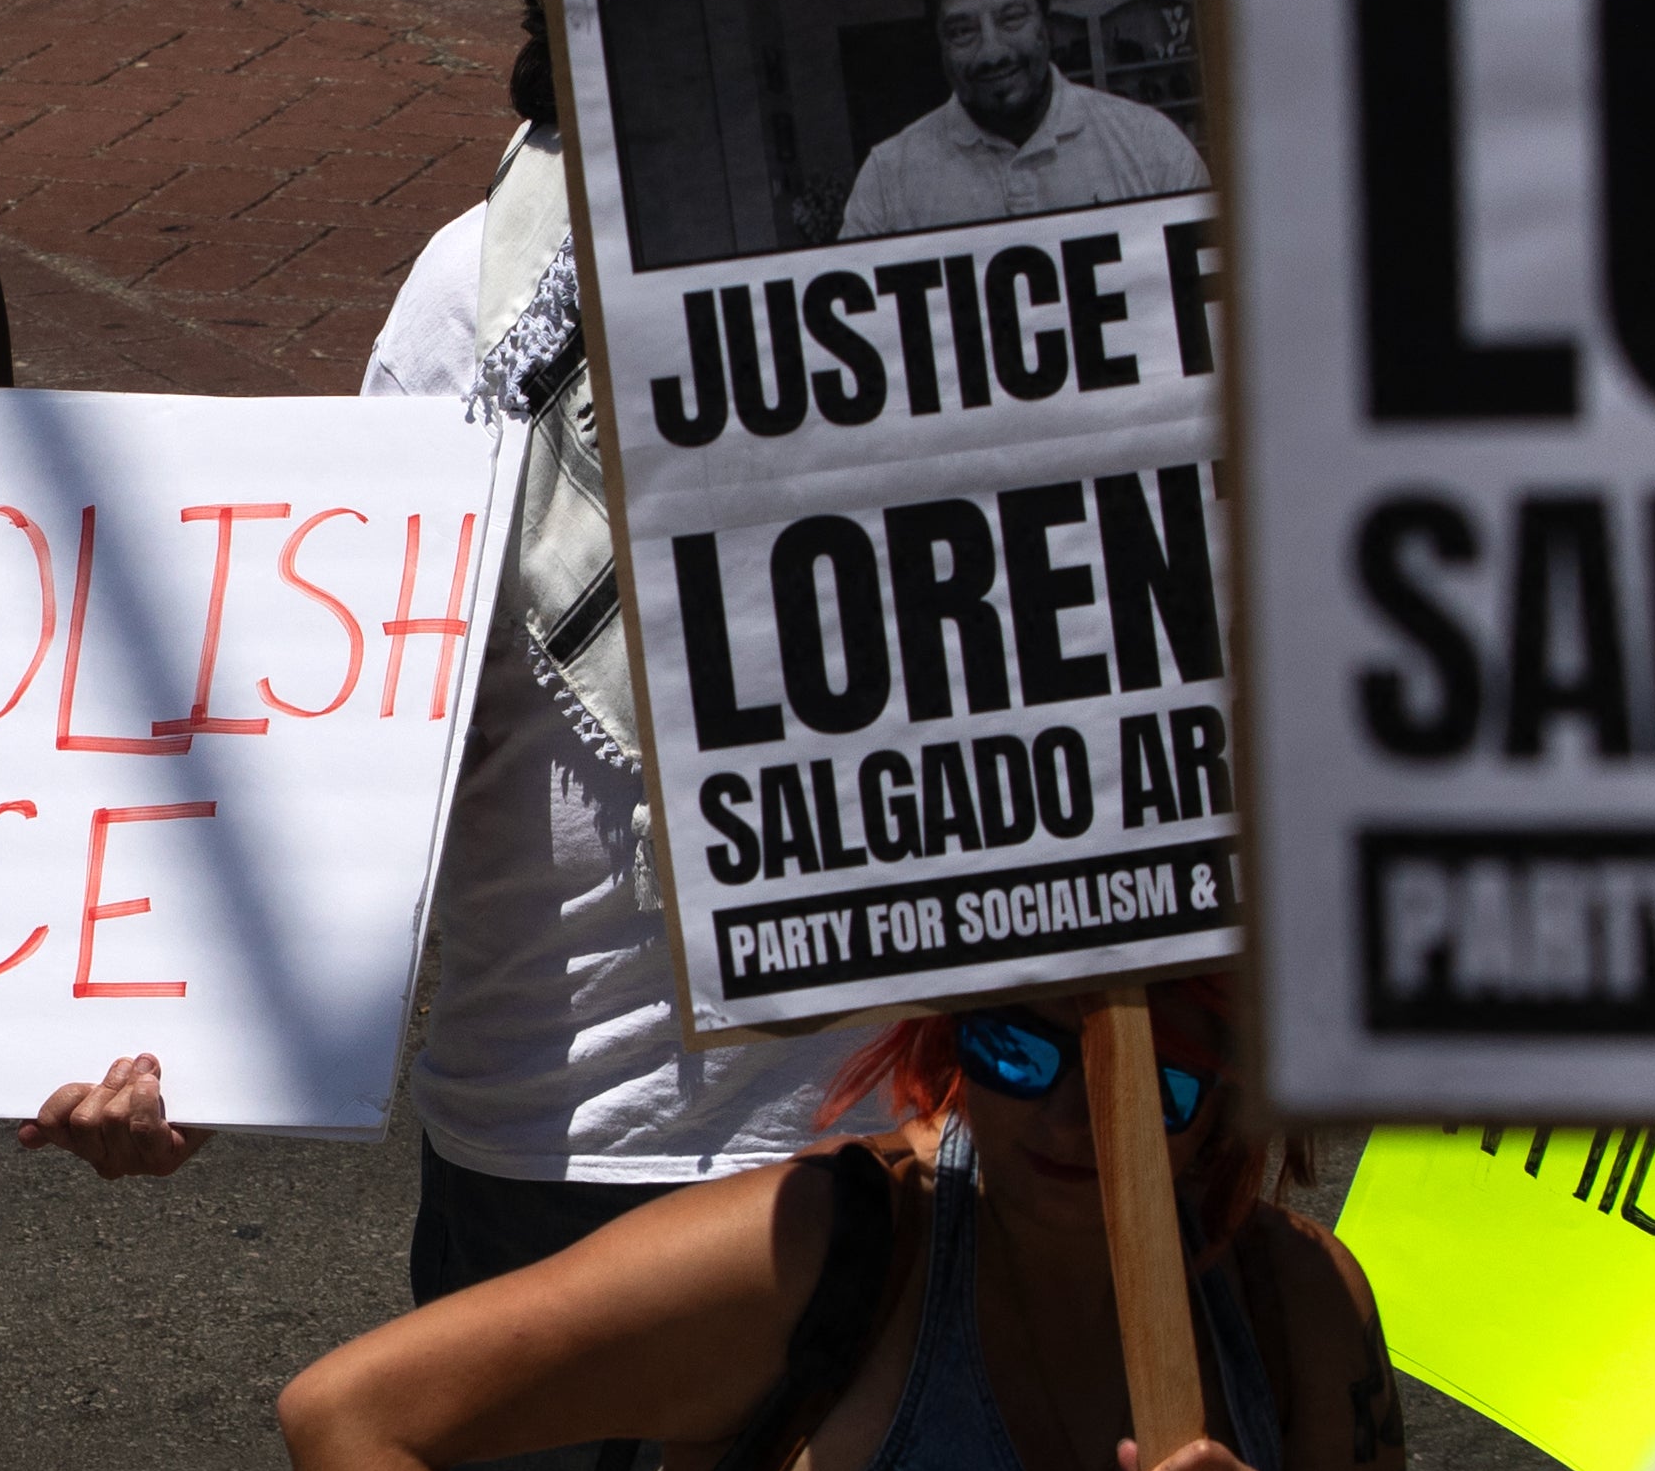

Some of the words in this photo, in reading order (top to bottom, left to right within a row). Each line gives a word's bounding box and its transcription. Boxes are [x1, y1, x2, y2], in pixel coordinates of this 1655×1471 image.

[650, 233, 1140, 448] JUSTICE
[671, 463, 1228, 751] LOREN
[698, 725, 1091, 885] SALGADO
[728, 909, 851, 978] PARTY
[867, 898, 945, 956] FOR
[958, 865, 1177, 943] SOCIALISM
[1191, 863, 1218, 910] &
